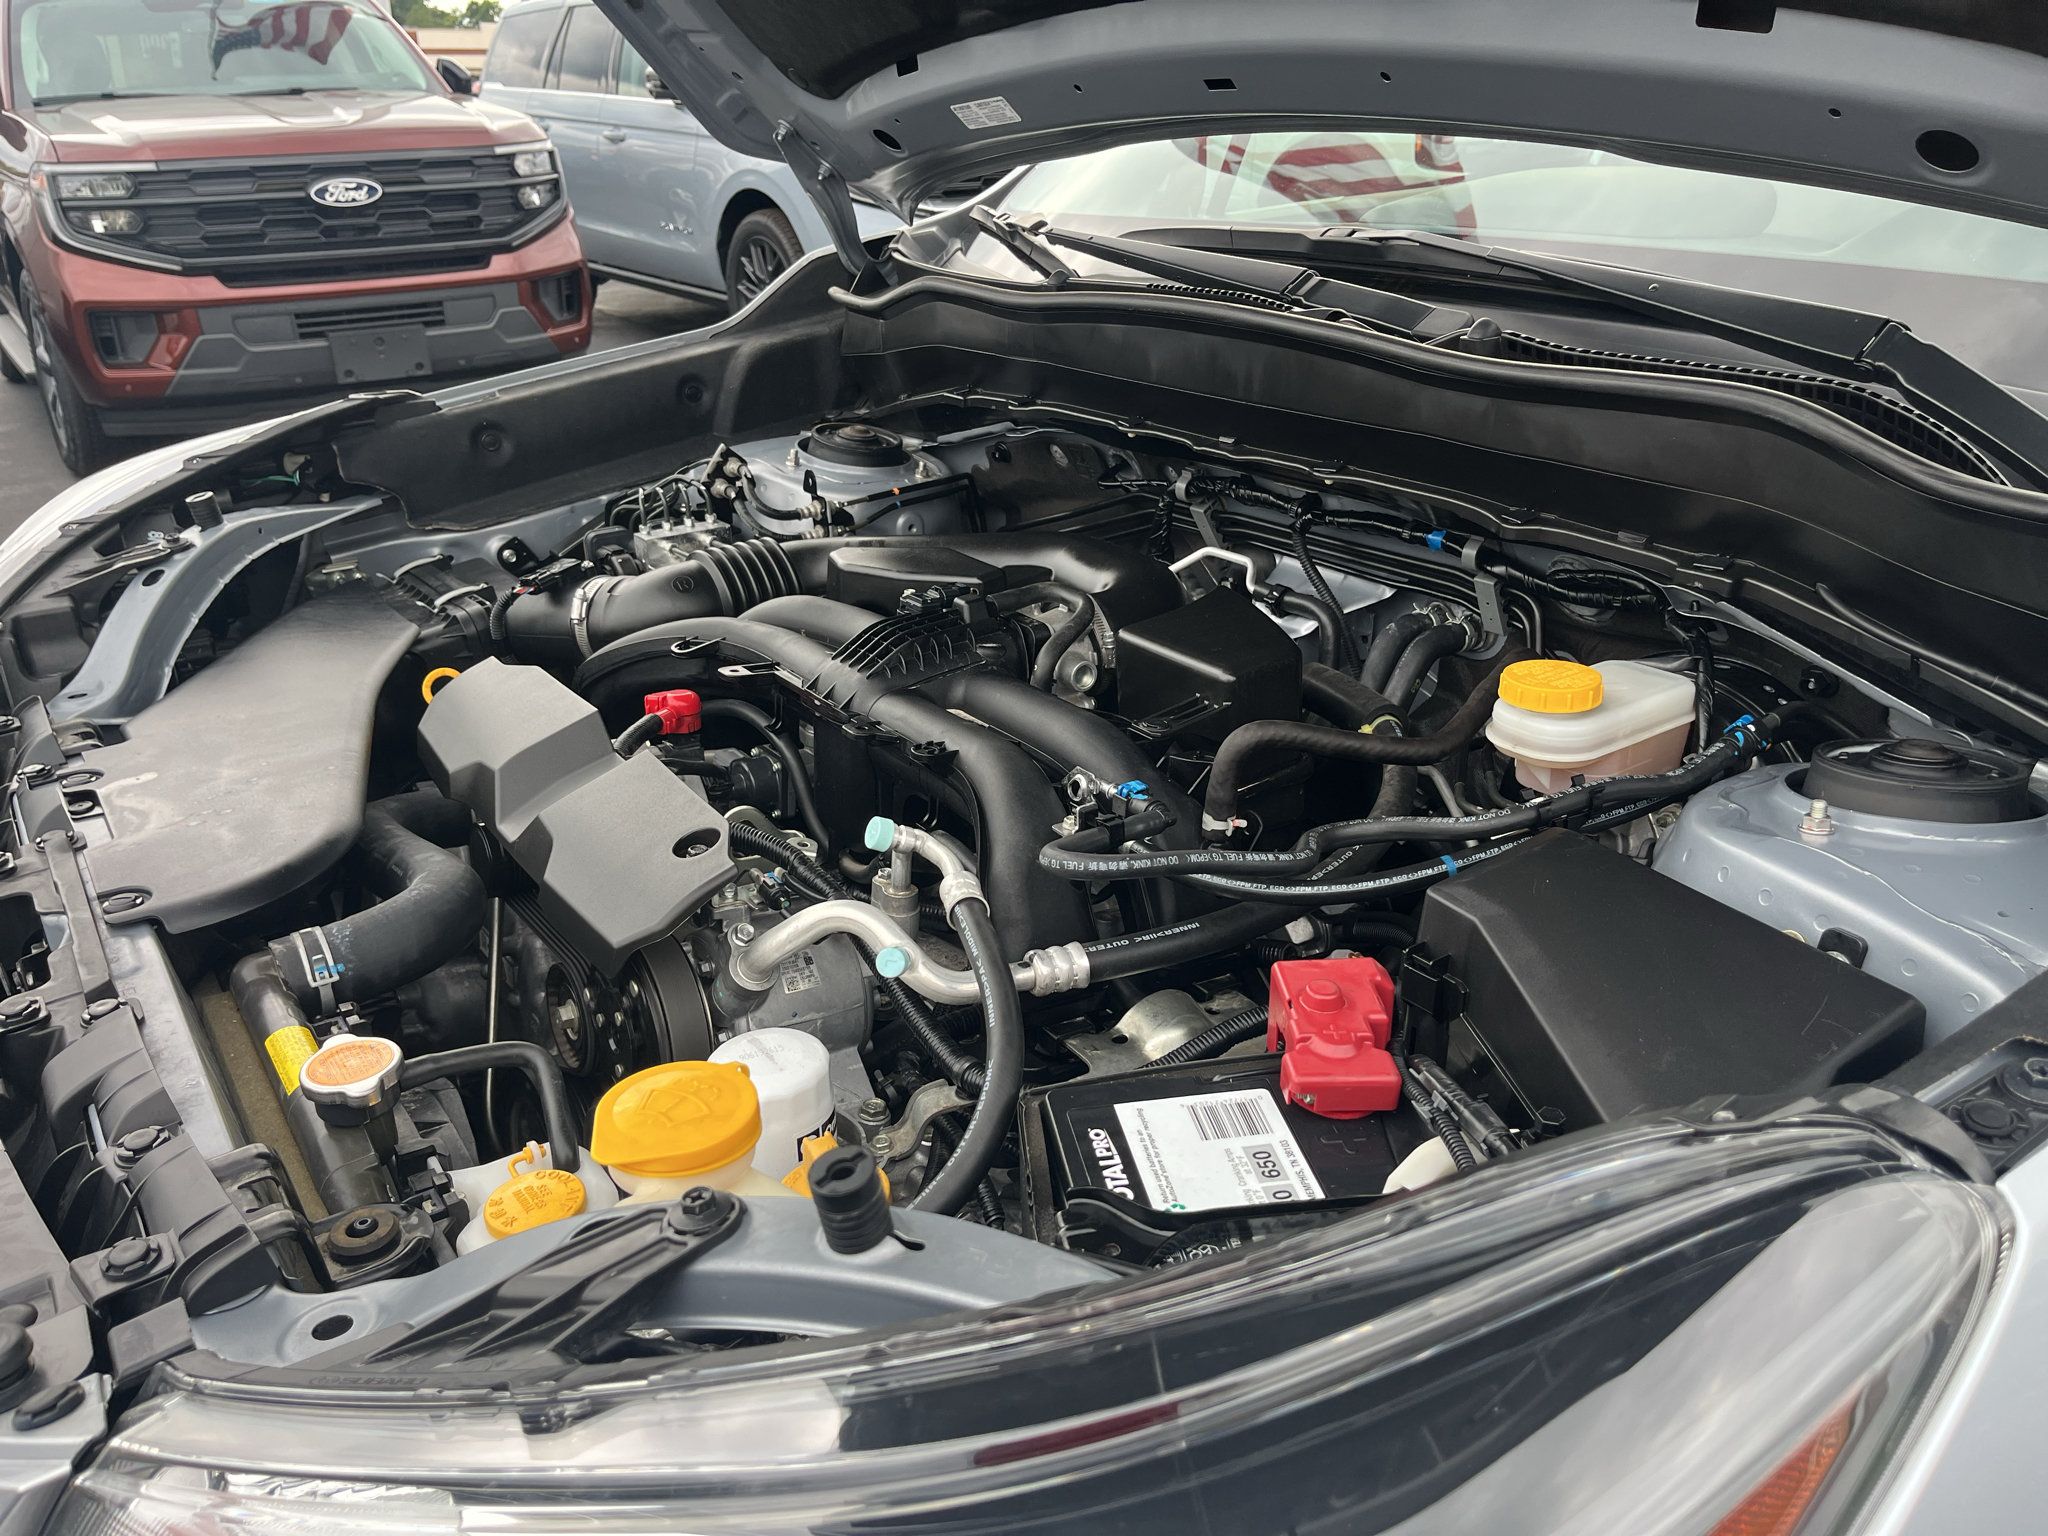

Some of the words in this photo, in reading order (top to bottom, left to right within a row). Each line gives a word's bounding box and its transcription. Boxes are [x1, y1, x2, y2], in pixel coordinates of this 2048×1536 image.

[323, 182, 370, 202] Ford
[1050, 859, 1061, 869] TG
[1062, 860, 1085, 871] FUEL
[1152, 856, 1168, 867] NOT
[1212, 852, 1223, 862] TG
[1223, 852, 1243, 862] FUEL
[1136, 1108, 1149, 1132] recycling
[1146, 1131, 1159, 1150] proper
[1279, 1139, 1296, 1158] 38103
[1088, 1128, 1134, 1201] OTALPRO
[1142, 1144, 1156, 1168] batteries
[1289, 1159, 1301, 1169] TN
[1157, 1159, 1167, 1174] store
[1252, 1151, 1281, 1179] 650
[1151, 1168, 1162, 1183] used
[1158, 1183, 1171, 1204] Return
